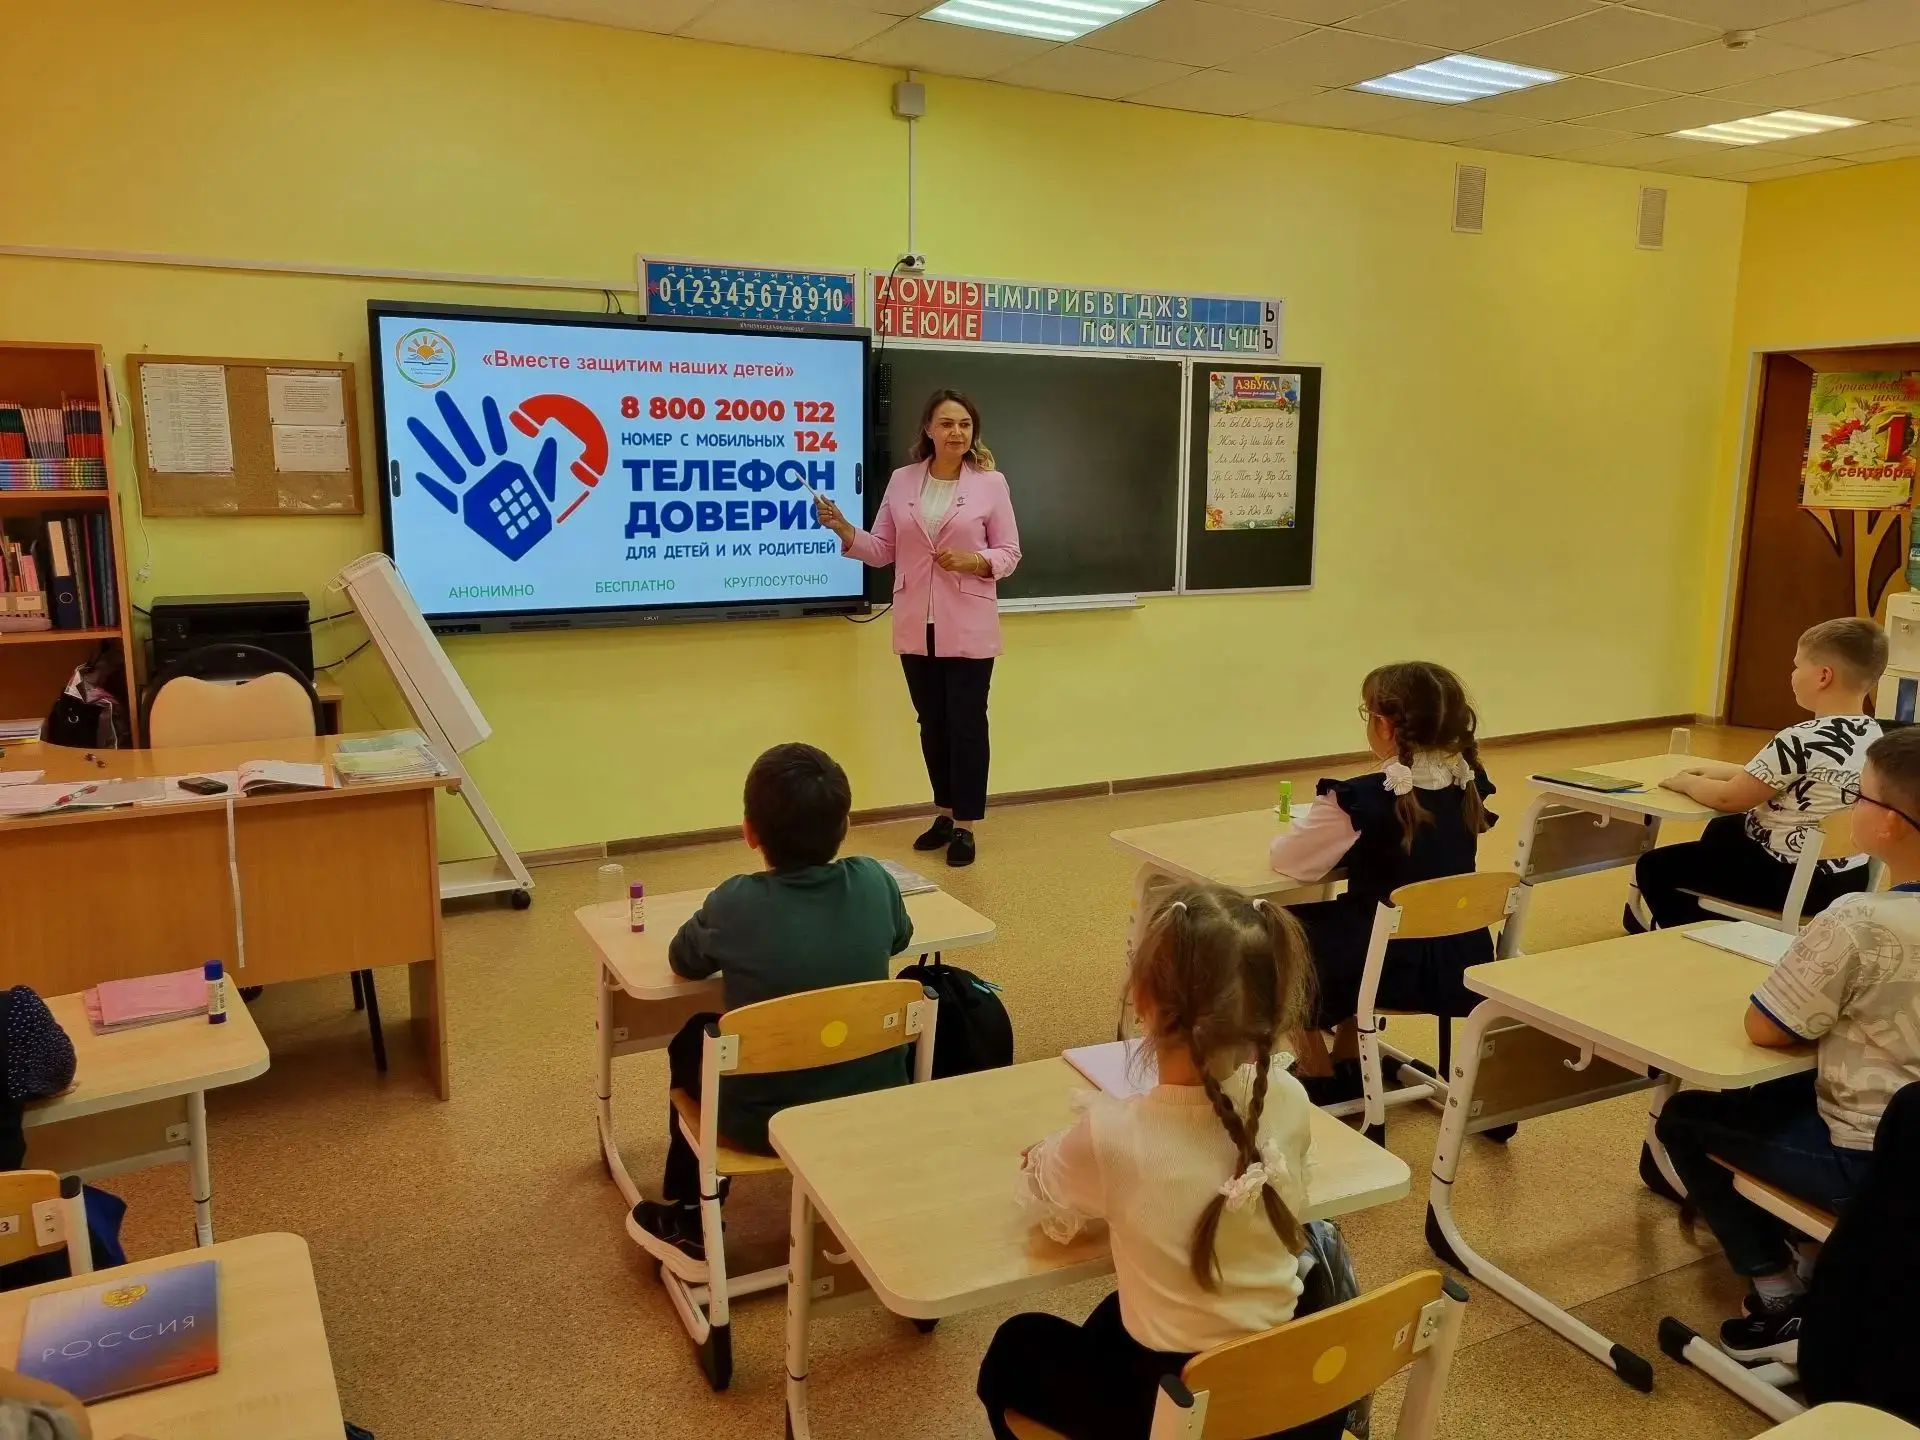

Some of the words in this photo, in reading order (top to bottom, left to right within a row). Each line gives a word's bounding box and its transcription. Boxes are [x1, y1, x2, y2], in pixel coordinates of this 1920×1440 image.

[660, 277, 671, 302] 0
[676, 279, 685, 302] 1
[693, 280, 703, 304] 2
[711, 281, 720, 304] 3
[727, 282, 738, 305] 4
[745, 283, 754, 306] 5
[761, 284, 771, 308] 6
[777, 286, 787, 308] 7
[792, 286, 802, 309] 8
[809, 287, 818, 310] 9
[824, 288, 843, 311] 10
[878, 277, 895, 300] А
[900, 279, 918, 302] О
[921, 280, 936, 302] У
[943, 281, 960, 304] Ы
[965, 283, 979, 306] Э
[985, 284, 998, 307] Н
[1004, 285, 1022, 308] М
[1025, 288, 1040, 310] Л
[1048, 289, 1058, 310] Р
[1084, 292, 1094, 313] Б
[1104, 292, 1114, 315] В
[1123, 293, 1134, 315] Г
[1138, 295, 1153, 319] Д
[1156, 296, 1172, 318] Ж
[1177, 297, 1187, 319] З
[1266, 302, 1274, 322] Ь
[902, 306, 913, 333] Ё
[921, 312, 939, 335] Ю
[943, 313, 958, 336] И
[966, 315, 977, 337] Е
[1083, 321, 1095, 343] П
[1100, 322, 1114, 343] Ф
[1121, 323, 1132, 345] К
[1140, 324, 1151, 345] Т
[1155, 325, 1171, 346] Ш
[1175, 325, 1187, 347] С
[1193, 324, 1205, 347] Х
[1211, 327, 1223, 351] Ц
[1229, 327, 1241, 348] Ч
[1243, 328, 1259, 352] Щ
[1262, 330, 1273, 349] Ъ
[483, 350, 570, 368] «Вместе
[577, 357, 662, 373] защитим
[669, 360, 728, 375] наших
[733, 361, 794, 378] детей»
[1235, 379, 1278, 391] АЗБУКА
[621, 396, 640, 419] 8
[649, 396, 706, 420] 800
[715, 398, 785, 422] 2000
[794, 401, 835, 423] 122
[621, 432, 672, 446] НОМЕР
[696, 434, 785, 448] МОБИЛЬНЫХ
[794, 430, 838, 452] 124
[1876, 413, 1908, 463] 1
[622, 459, 835, 492] ТЕЛЕФОН
[626, 546, 656, 560] ДЛЯ
[664, 542, 710, 560] ДЕТЕЙ
[716, 544, 726, 557] И
[732, 543, 752, 557] ИХ
[759, 539, 836, 557] РОДИТЕЛЕЙ
[449, 584, 534, 598] АНОНИМНО
[595, 579, 676, 593] БЕСПЛАТНО
[724, 574, 829, 588] КРУГЛОСУТОЧНО
[42, 1315, 195, 1362] РОССИЯ
